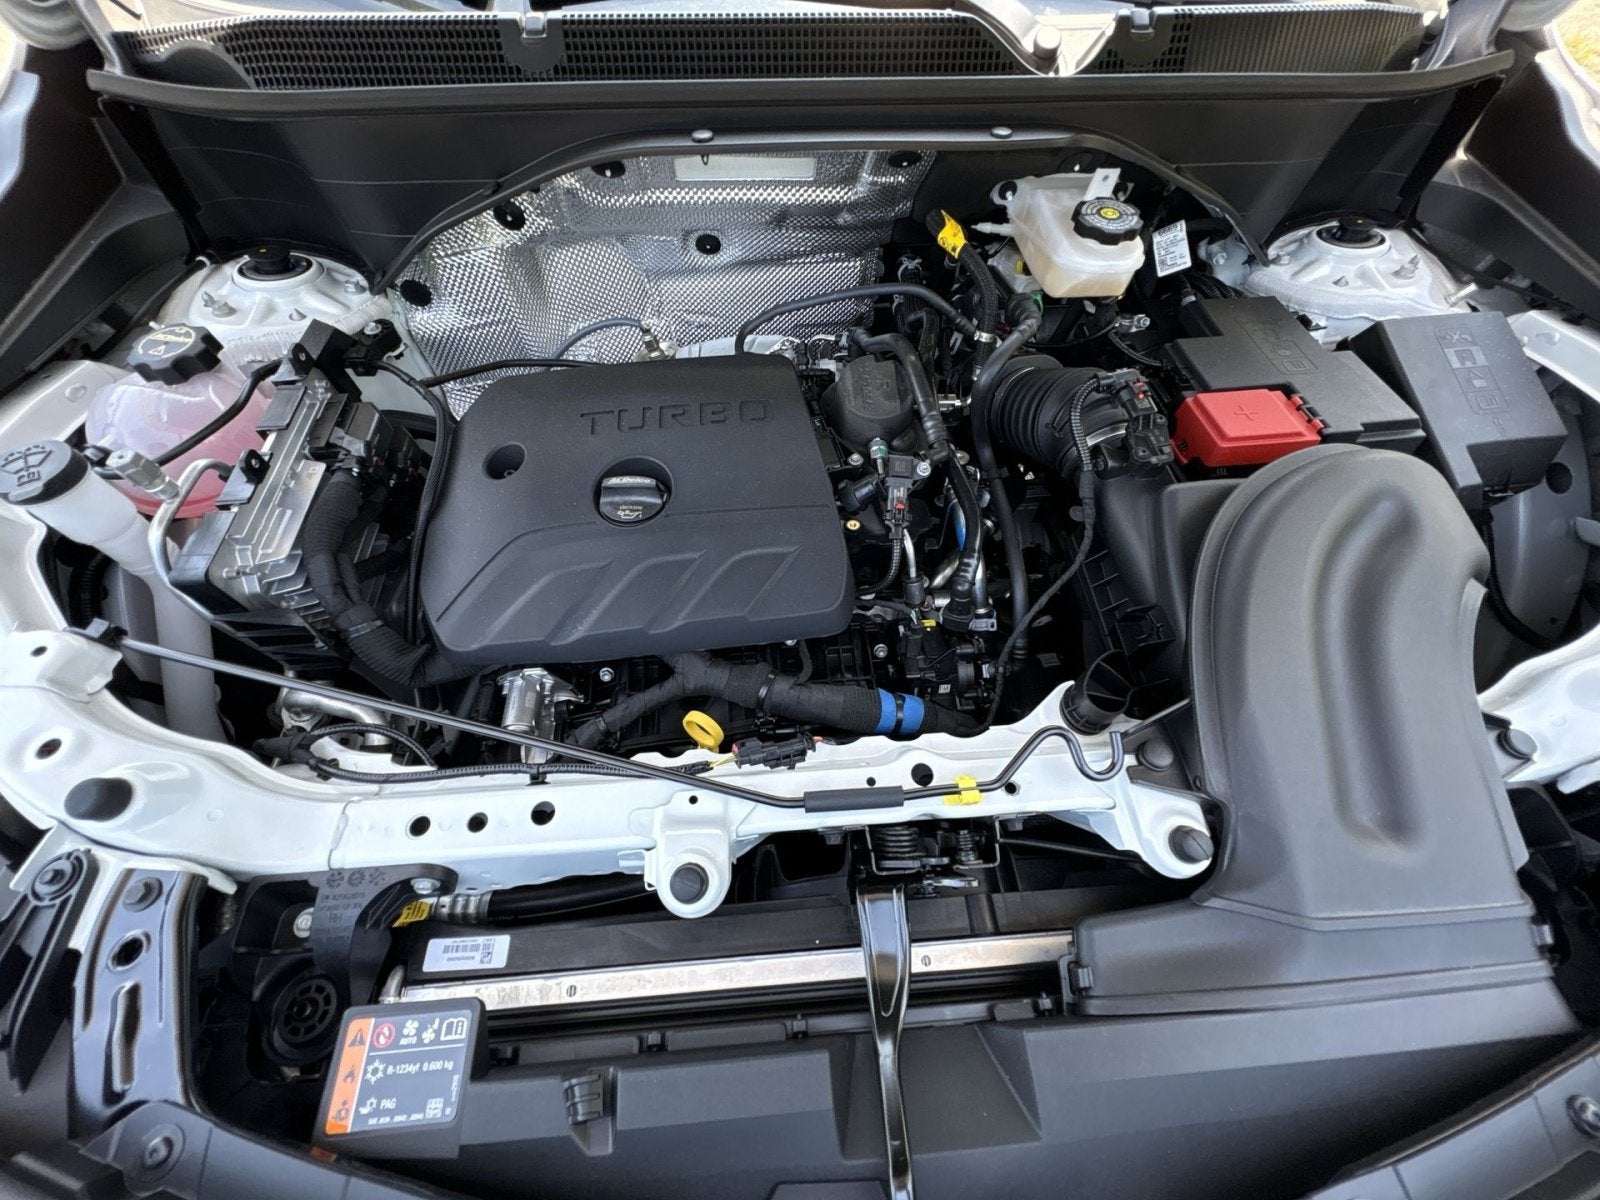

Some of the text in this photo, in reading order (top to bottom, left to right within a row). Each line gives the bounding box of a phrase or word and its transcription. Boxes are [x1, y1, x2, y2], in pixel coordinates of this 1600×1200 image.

[580, 401, 774, 435] TURBO
[399, 1036, 418, 1046] AUTO
[386, 1059, 454, 1075] R-1234yf 0.600 kg
[380, 1098, 397, 1110] PAG
